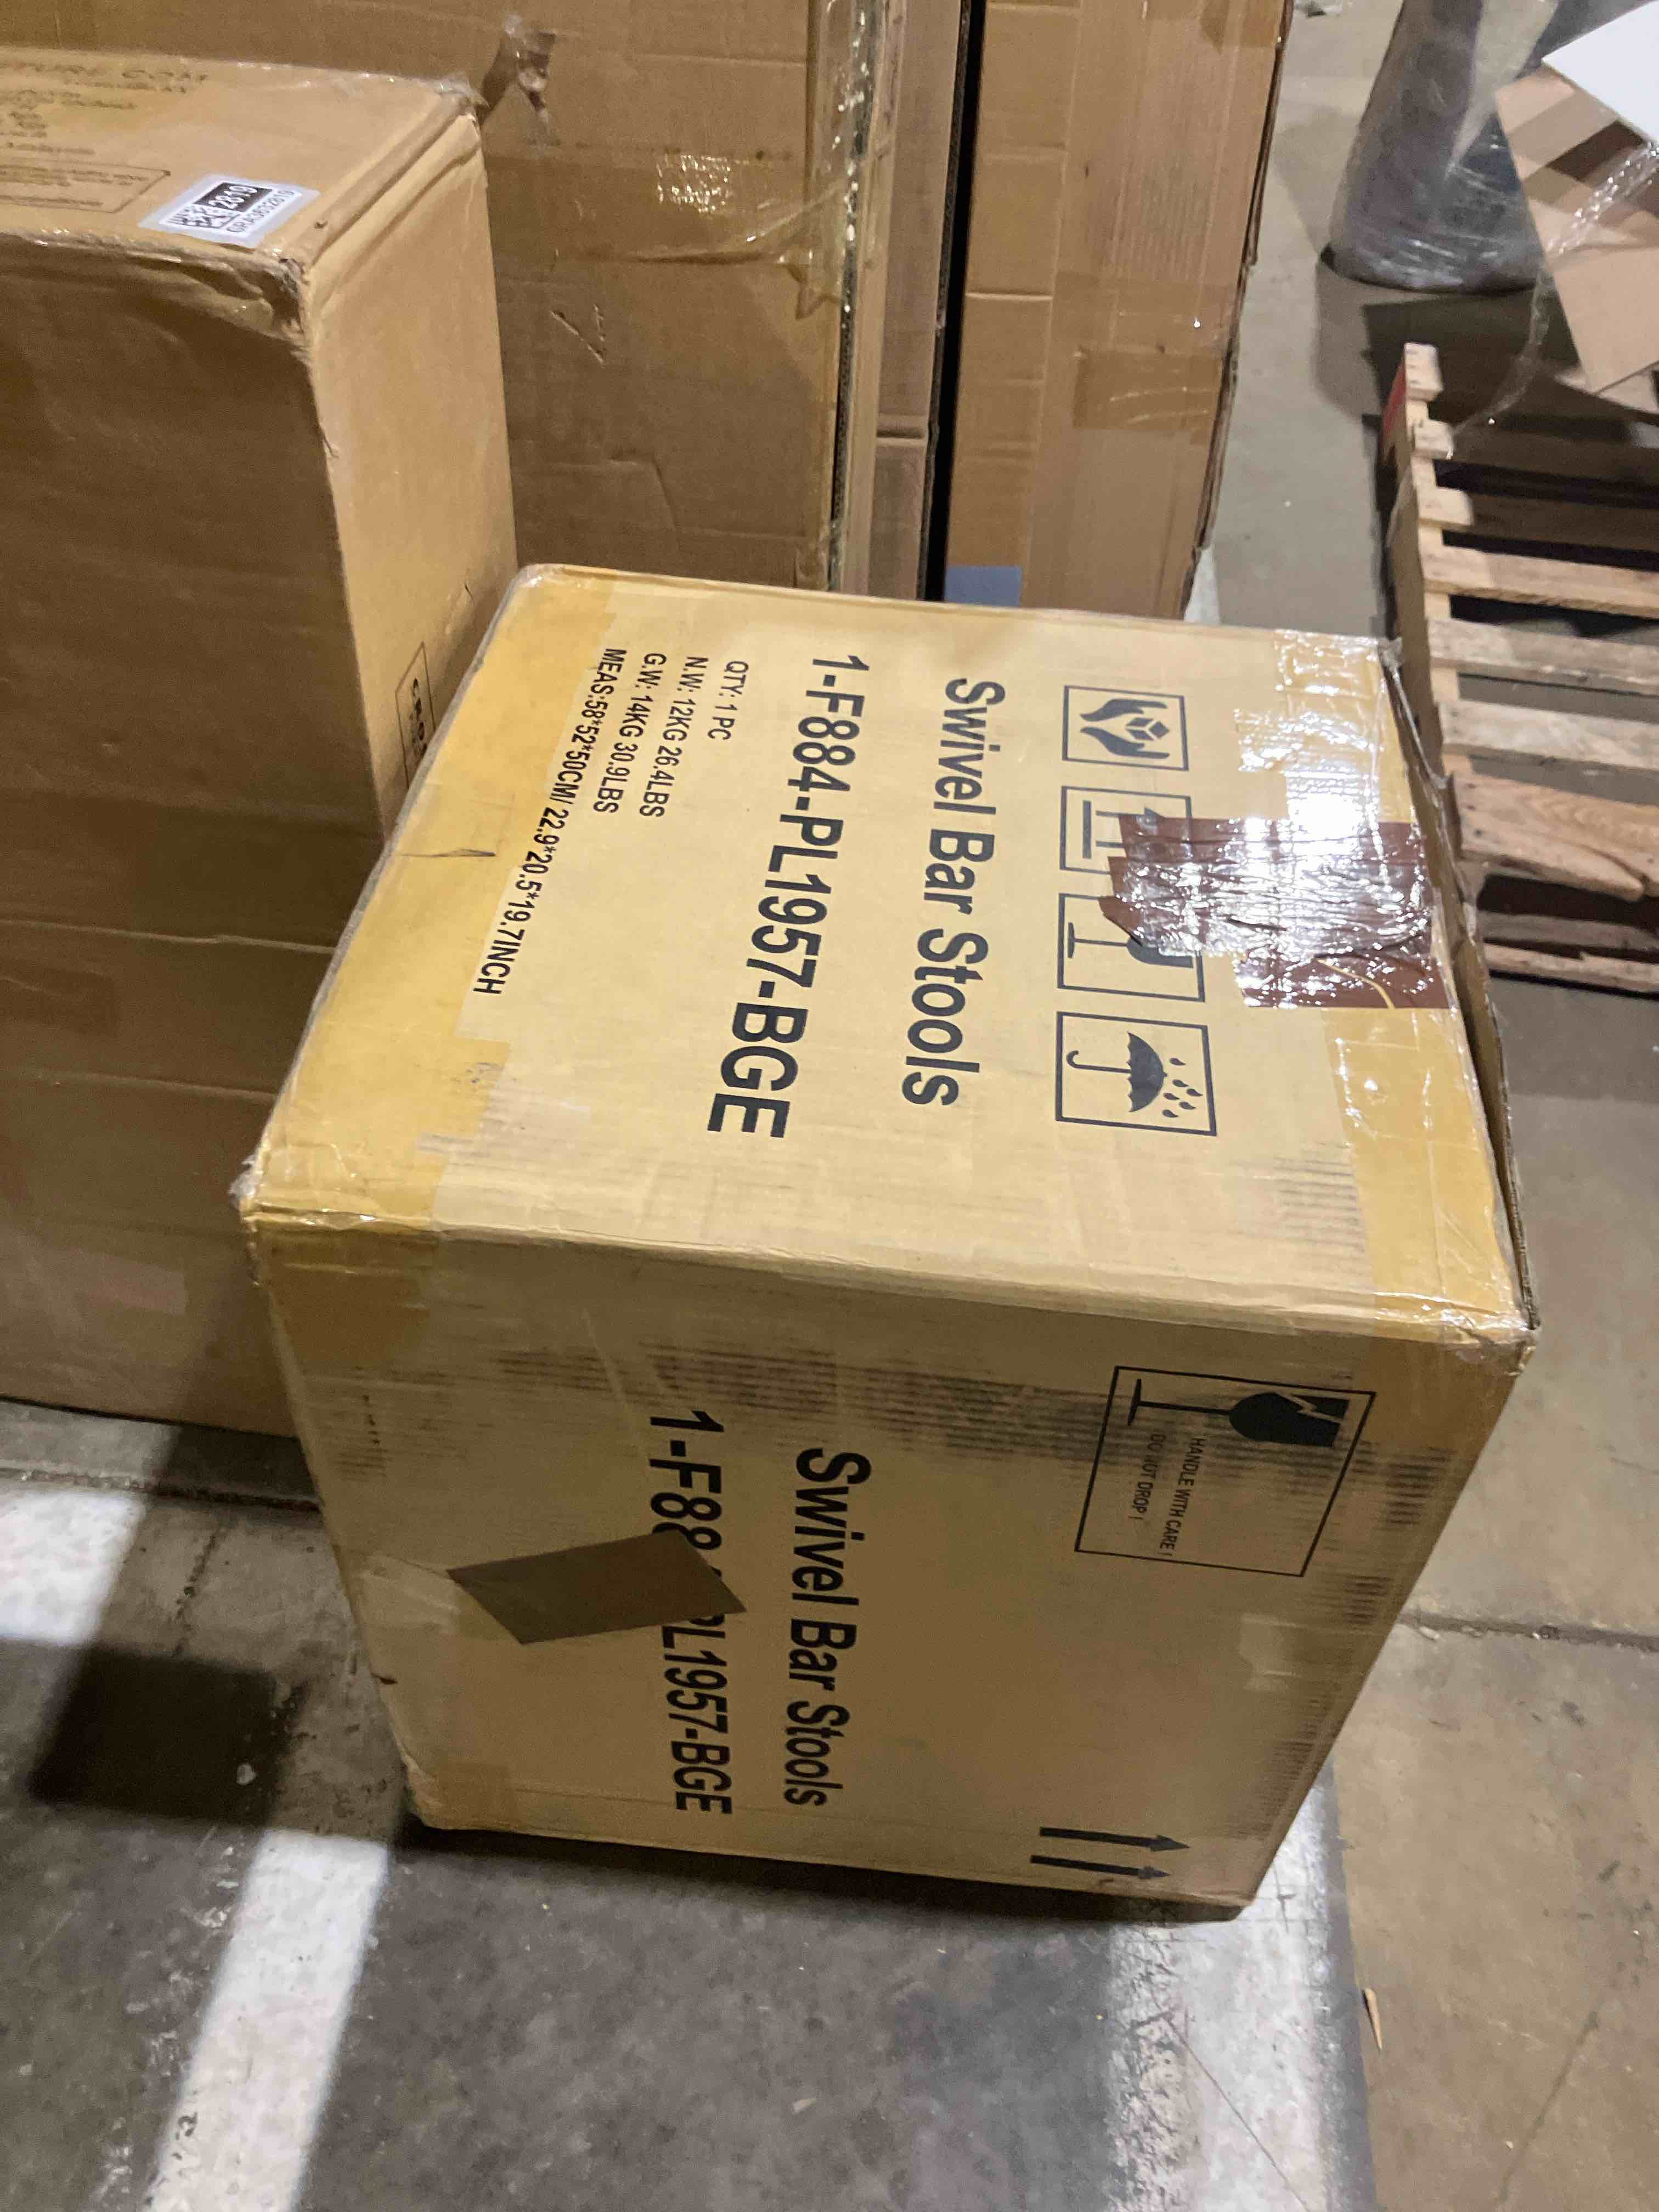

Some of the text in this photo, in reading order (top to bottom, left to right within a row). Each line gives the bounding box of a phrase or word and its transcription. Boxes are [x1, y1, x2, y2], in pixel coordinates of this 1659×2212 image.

[593, 652, 667, 814] G.W: 14KG 30.9LBS
[639, 656, 709, 818] N.W: 12KG 26.4LBS
[707, 661, 749, 741] QTY: 1 PC
[707, 654, 870, 1138] 1-F884-PL1957-BGE
[901, 677, 1006, 1106] Swivel Bar Stools
[1132, 1482, 1153, 1513] DROP
[1160, 1520, 1181, 1550] CARE
[1169, 1489, 1190, 1517] WITH
[1178, 1437, 1207, 1486] HANDLE
[650, 1408, 733, 1815] 1-F88L1957-BGE
[785, 1447, 872, 1807] Swivel Bar Stools
